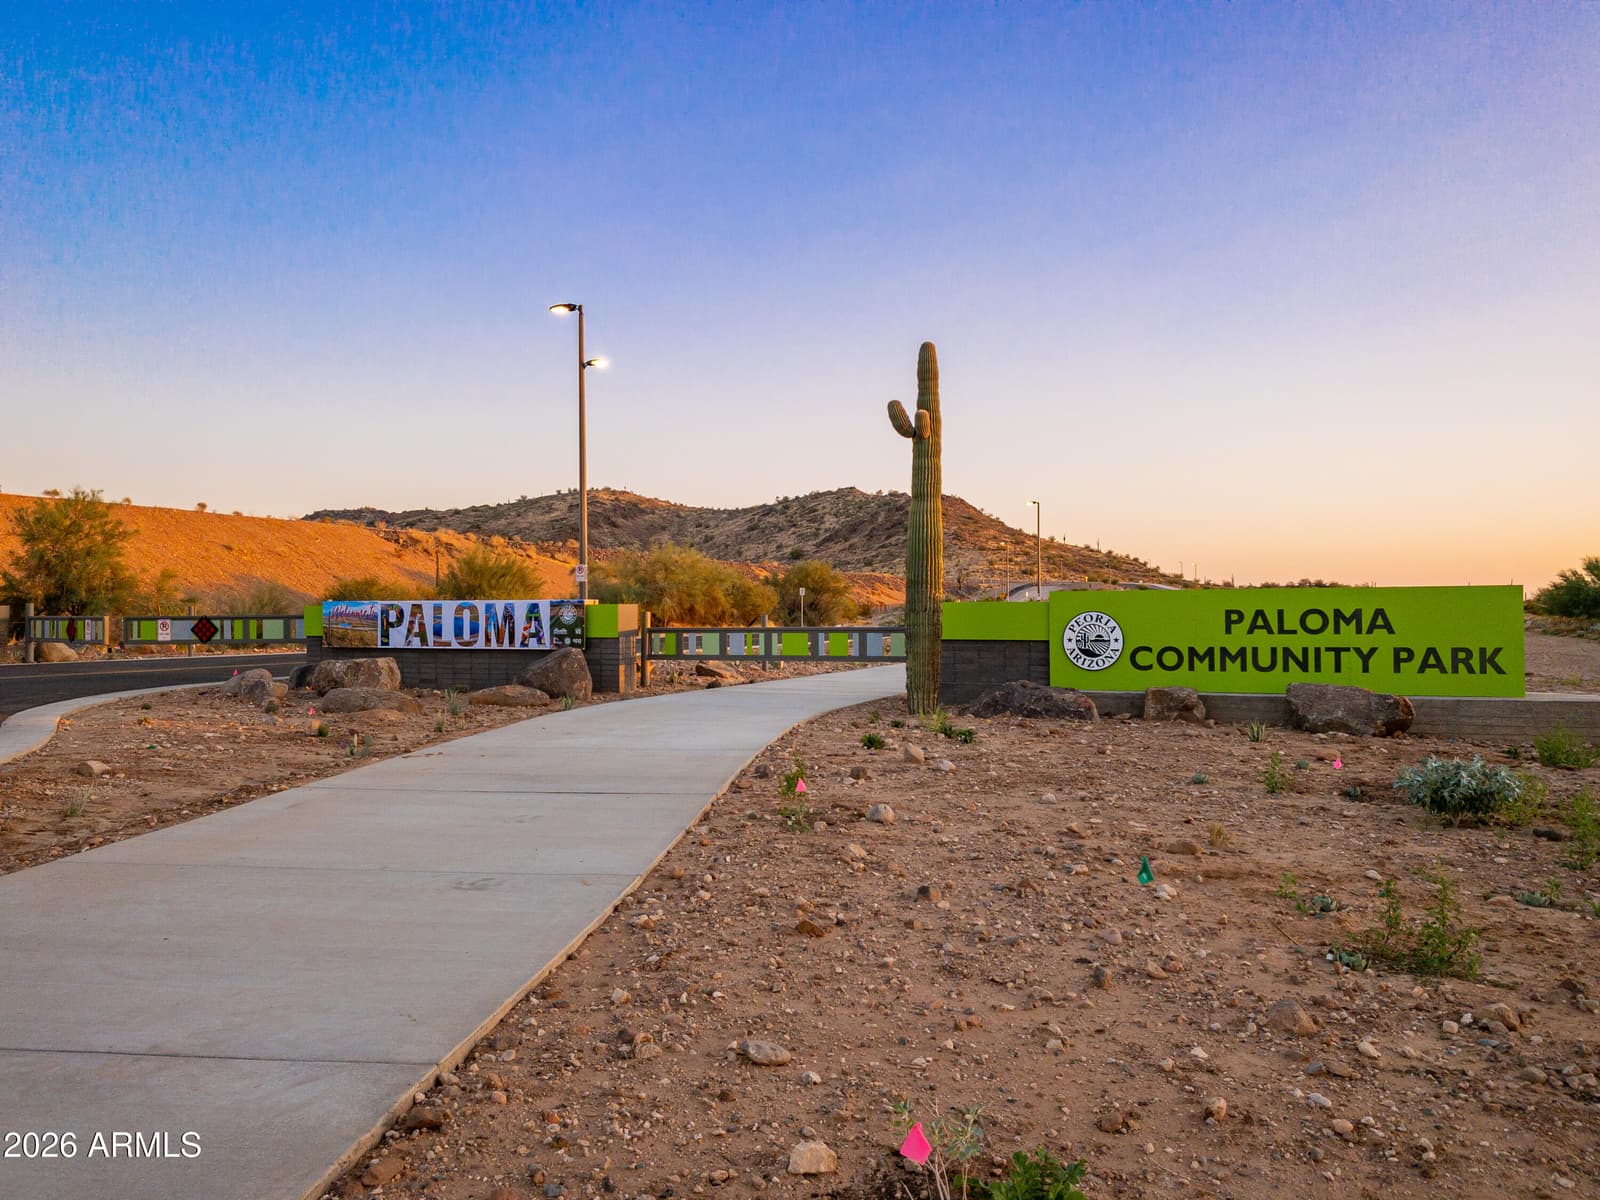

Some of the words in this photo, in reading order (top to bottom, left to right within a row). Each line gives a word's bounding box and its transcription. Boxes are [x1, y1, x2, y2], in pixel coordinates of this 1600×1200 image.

[380, 602, 546, 647] PALOMA
[1068, 613, 1117, 633] PEORIA
[1225, 608, 1396, 635] PALOMA
[1067, 648, 1120, 668] ARIZONA
[1129, 645, 1378, 674] COMMUNITY
[1395, 645, 1507, 675] PARK
